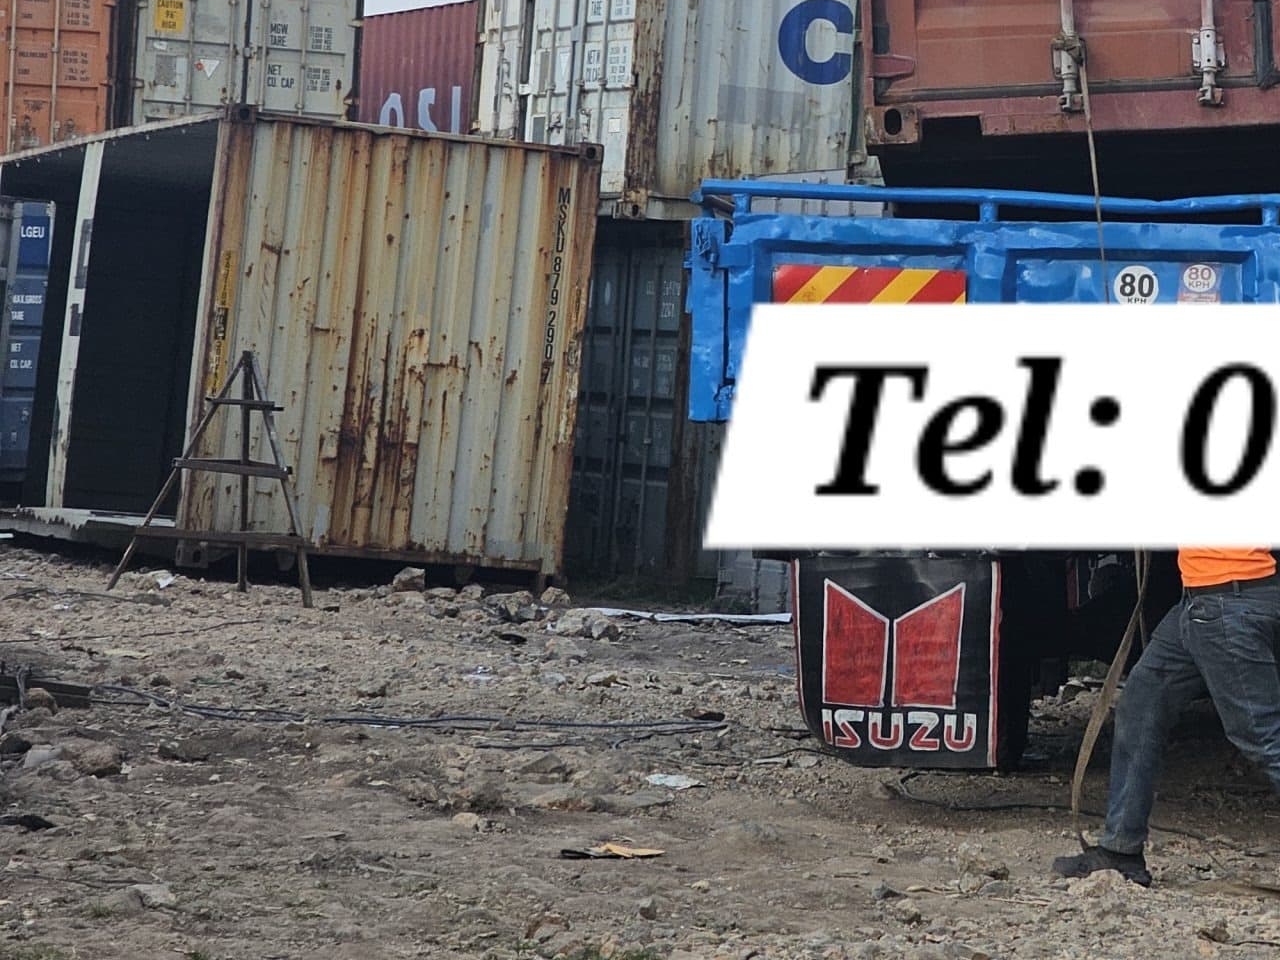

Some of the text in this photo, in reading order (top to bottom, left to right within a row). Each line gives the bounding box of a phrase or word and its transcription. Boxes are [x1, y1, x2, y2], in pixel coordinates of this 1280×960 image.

[157, 0, 184, 9] CAUTION
[270, 23, 288, 35] MGW
[270, 35, 287, 47] TARE
[267, 64, 282, 76] NET
[555, 187, 571, 254] MSKU
[21, 225, 45, 239] LGEU
[1188, 267, 1212, 281] 80
[1119, 273, 1155, 298] 80
[1189, 280, 1211, 289] KPH
[822, 709, 977, 752] ISUZU
